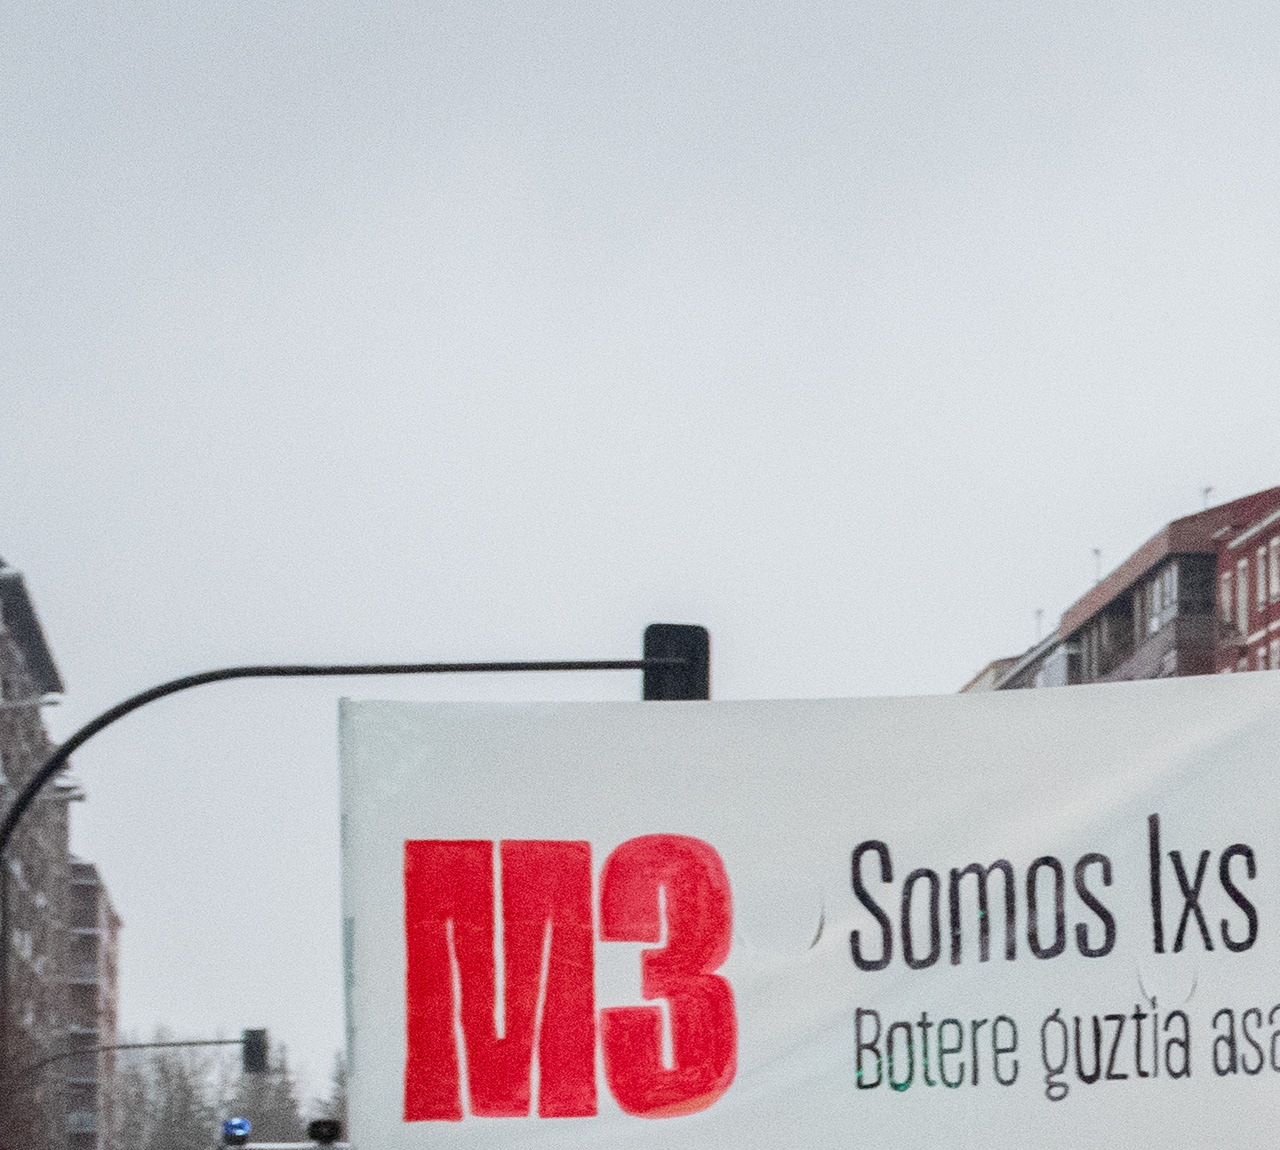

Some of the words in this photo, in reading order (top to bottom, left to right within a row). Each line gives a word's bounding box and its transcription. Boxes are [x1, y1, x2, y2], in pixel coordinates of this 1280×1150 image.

[849, 839, 1117, 972] Somos
[1148, 814, 1259, 954] lxs
[403, 833, 737, 1123] M3
[854, 1007, 1019, 1093] Botere
[1040, 997, 1192, 1102] guztia
